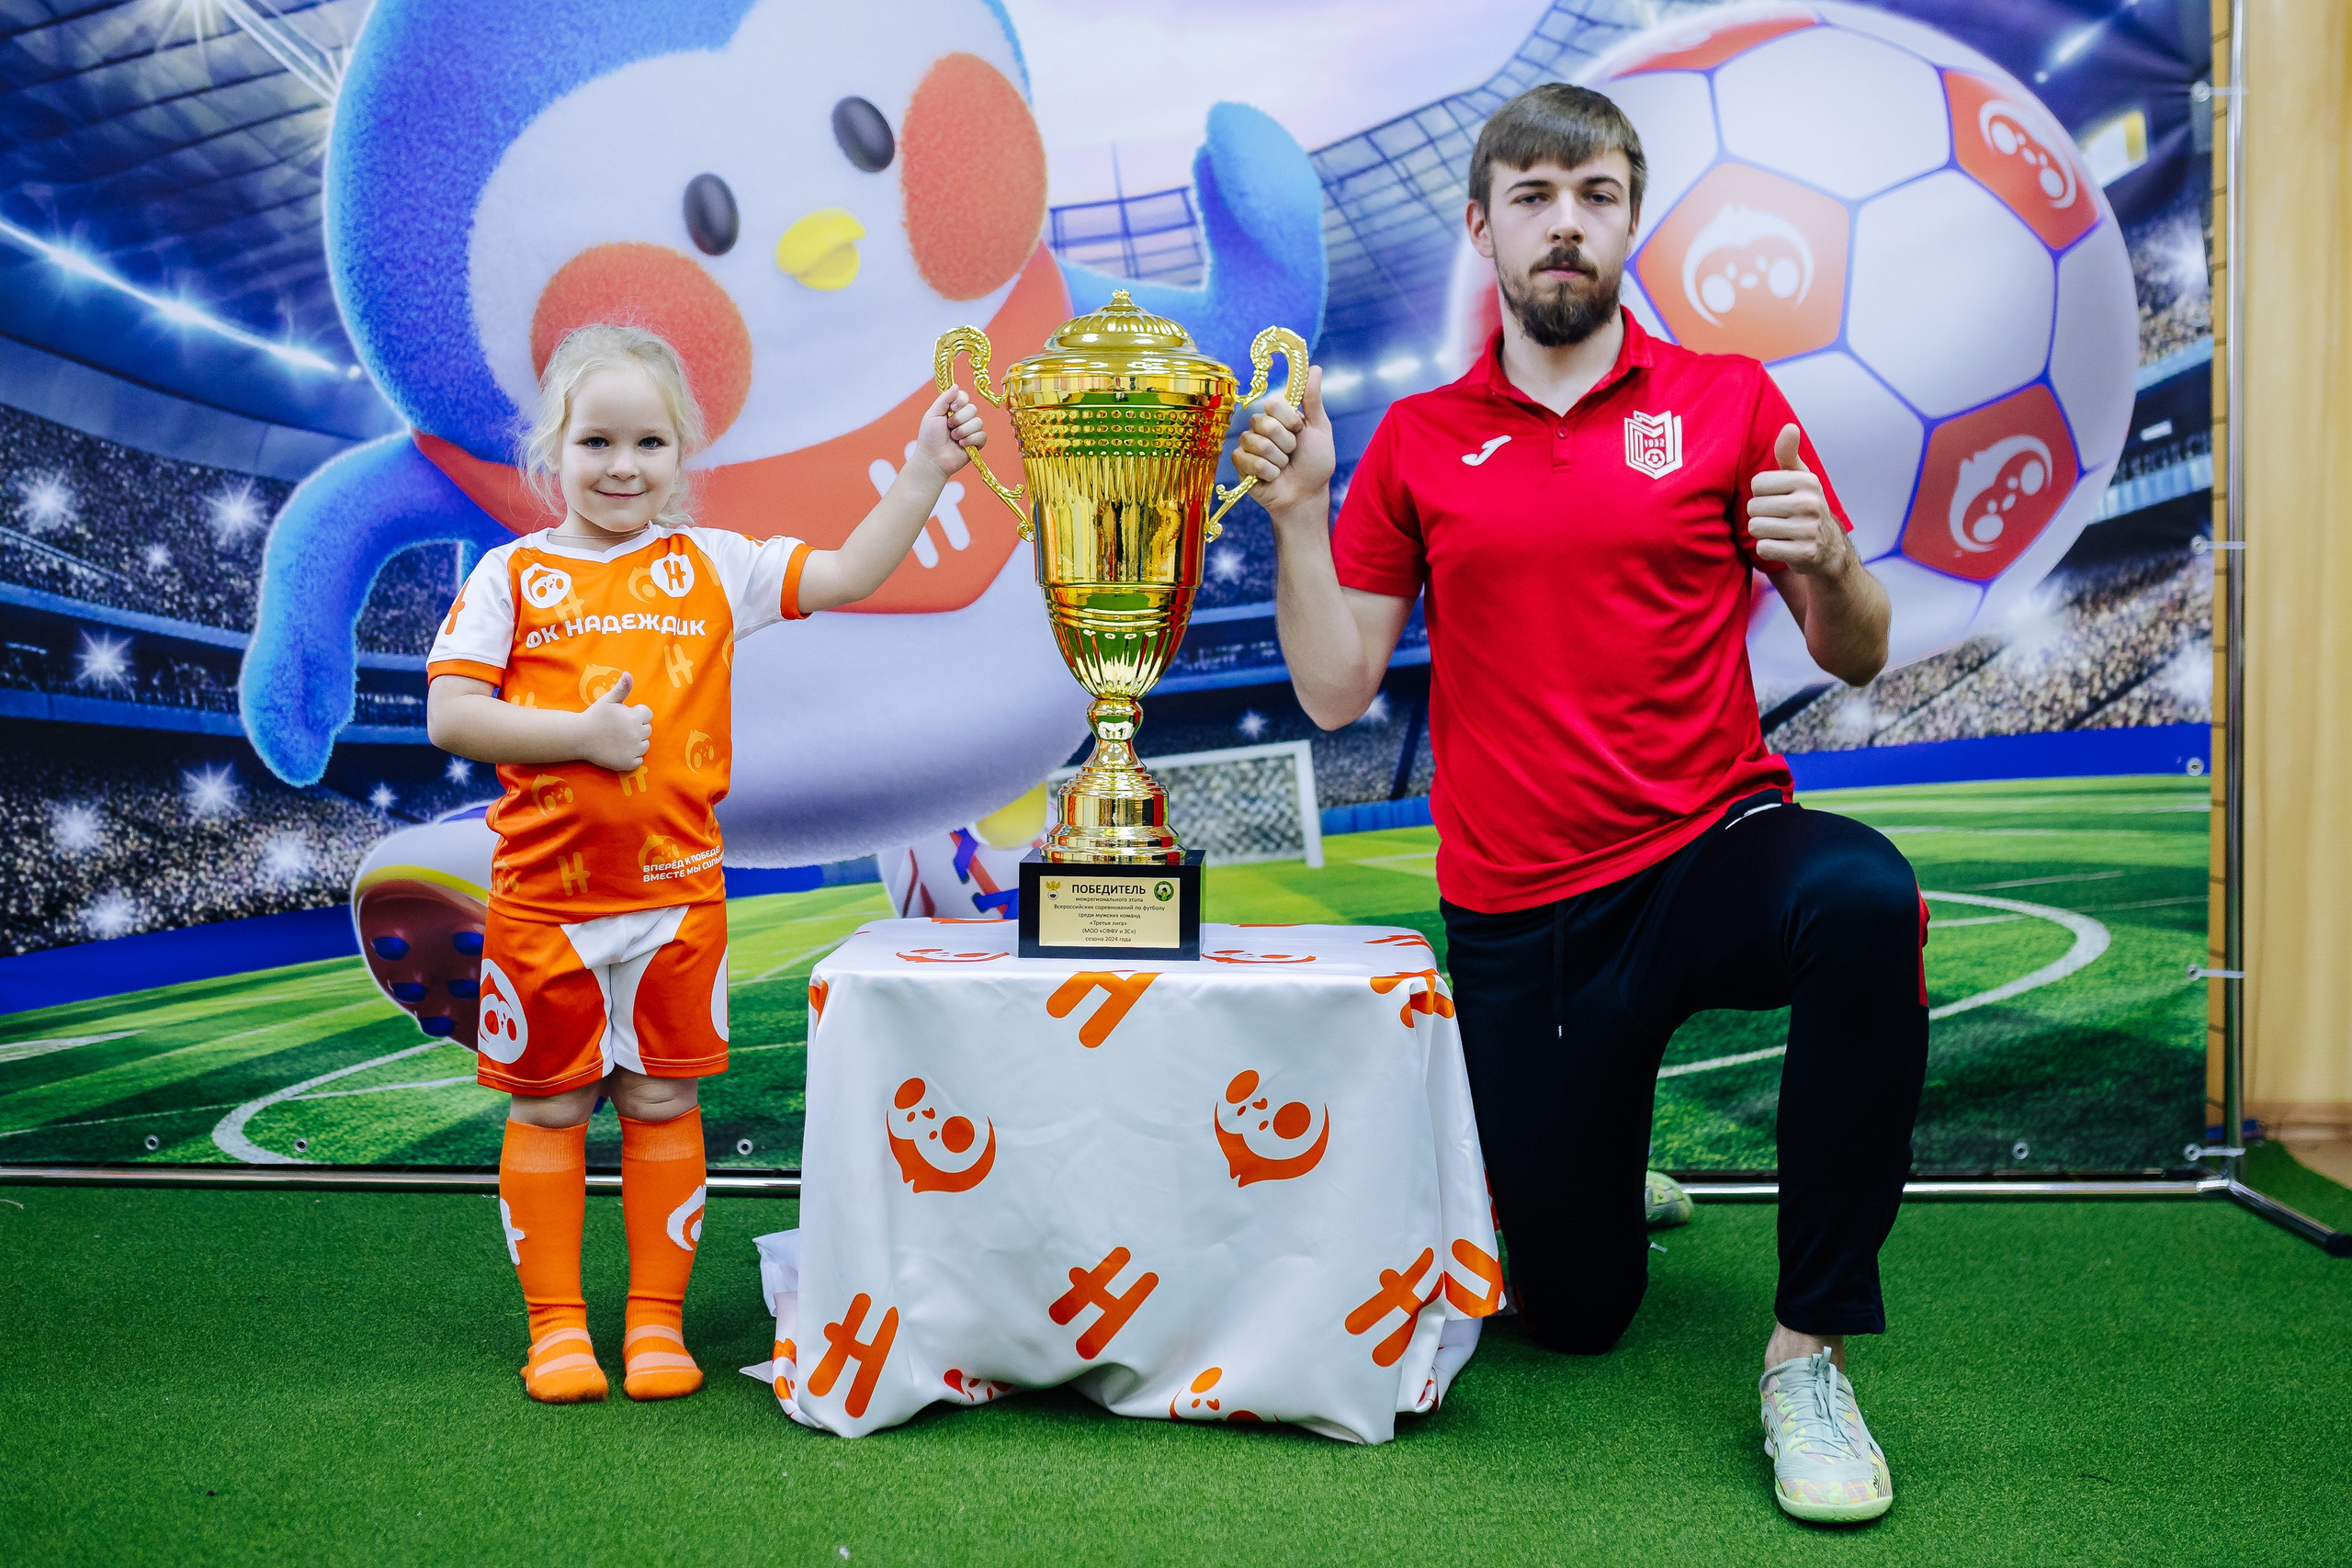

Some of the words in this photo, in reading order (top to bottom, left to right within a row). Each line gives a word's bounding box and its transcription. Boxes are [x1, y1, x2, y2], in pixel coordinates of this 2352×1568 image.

[526, 624, 560, 649] ФК
[565, 613, 707, 637] НАДЕЖДИК
[643, 859, 684, 873] ВПЕРЁД
[684, 857, 692, 865] К
[643, 870, 685, 883] ВМЕСТЕ
[686, 864, 701, 875] МЫ
[1071, 884, 1147, 896] ПОБЕДИТЕЛЬ
